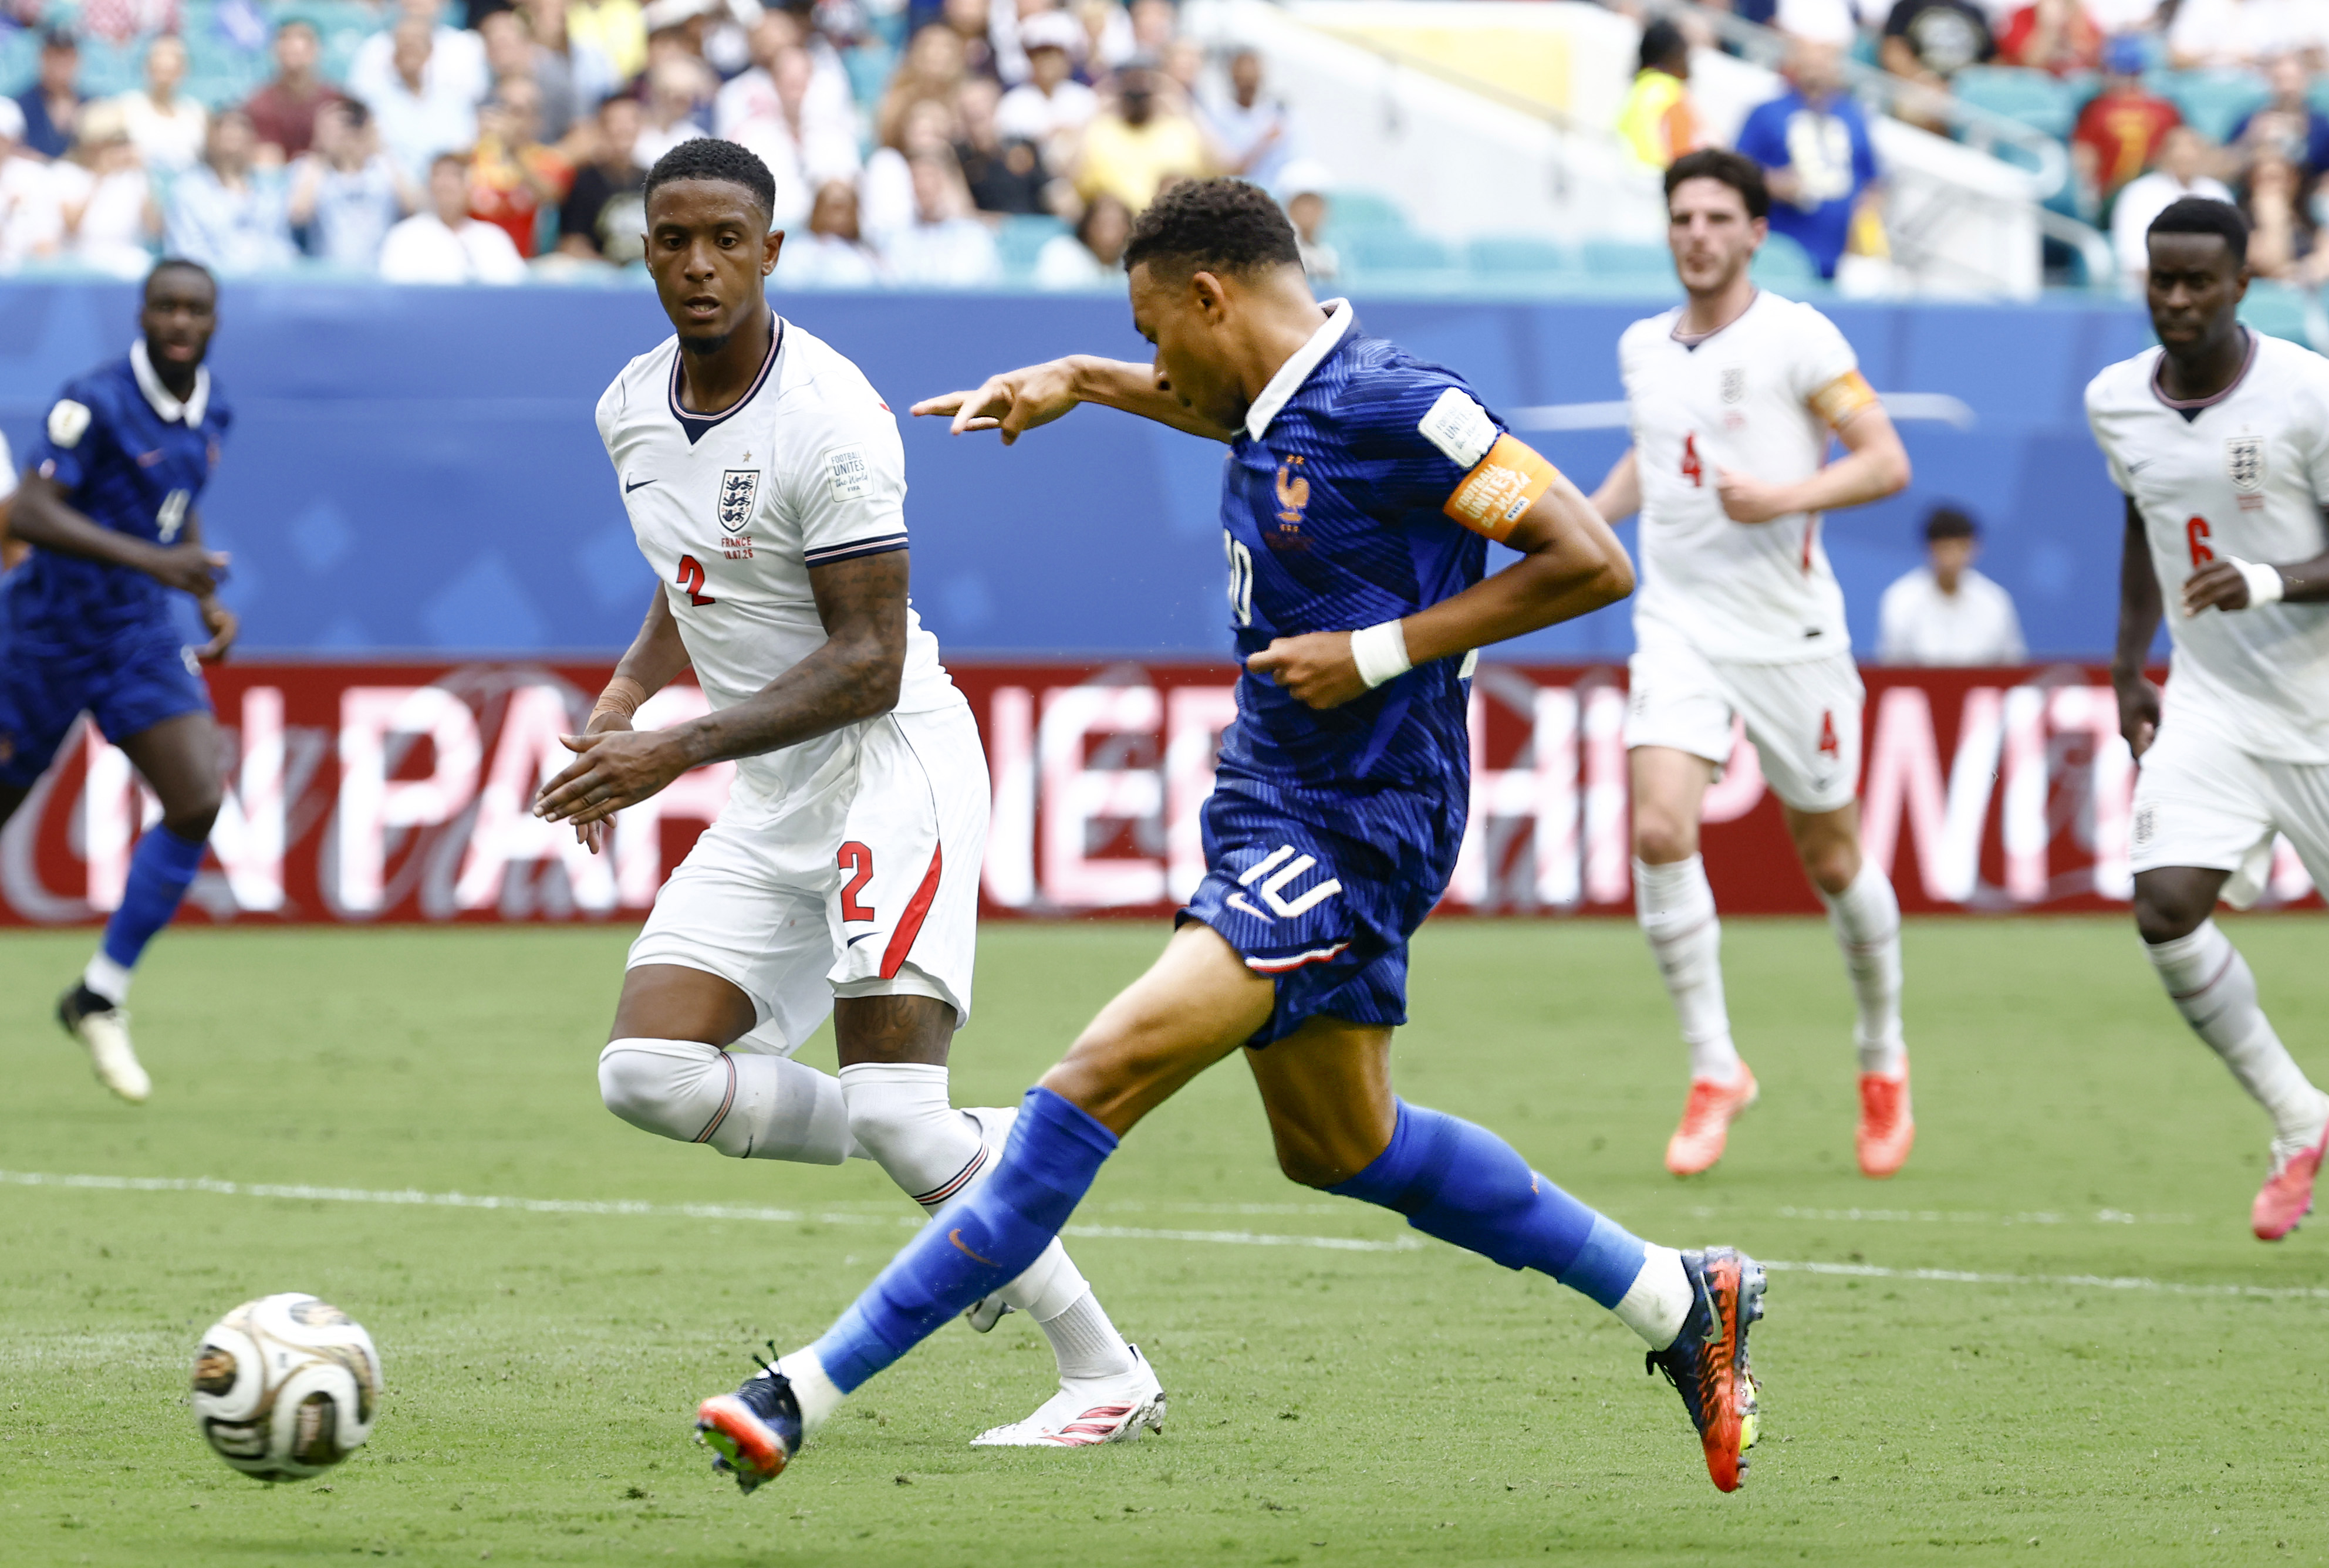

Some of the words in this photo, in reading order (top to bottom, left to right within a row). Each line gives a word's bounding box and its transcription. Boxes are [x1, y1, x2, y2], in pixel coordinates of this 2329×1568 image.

[831, 451, 861, 464] FOOTBALL
[833, 459, 865, 476] UNITES
[1680, 431, 1704, 488] 4
[156, 488, 191, 544] 4
[1466, 469, 1517, 519] UNITES
[721, 536, 752, 548] FRANCE
[2186, 513, 2215, 569] 6
[676, 554, 716, 607] 2
[837, 841, 875, 922] 2
